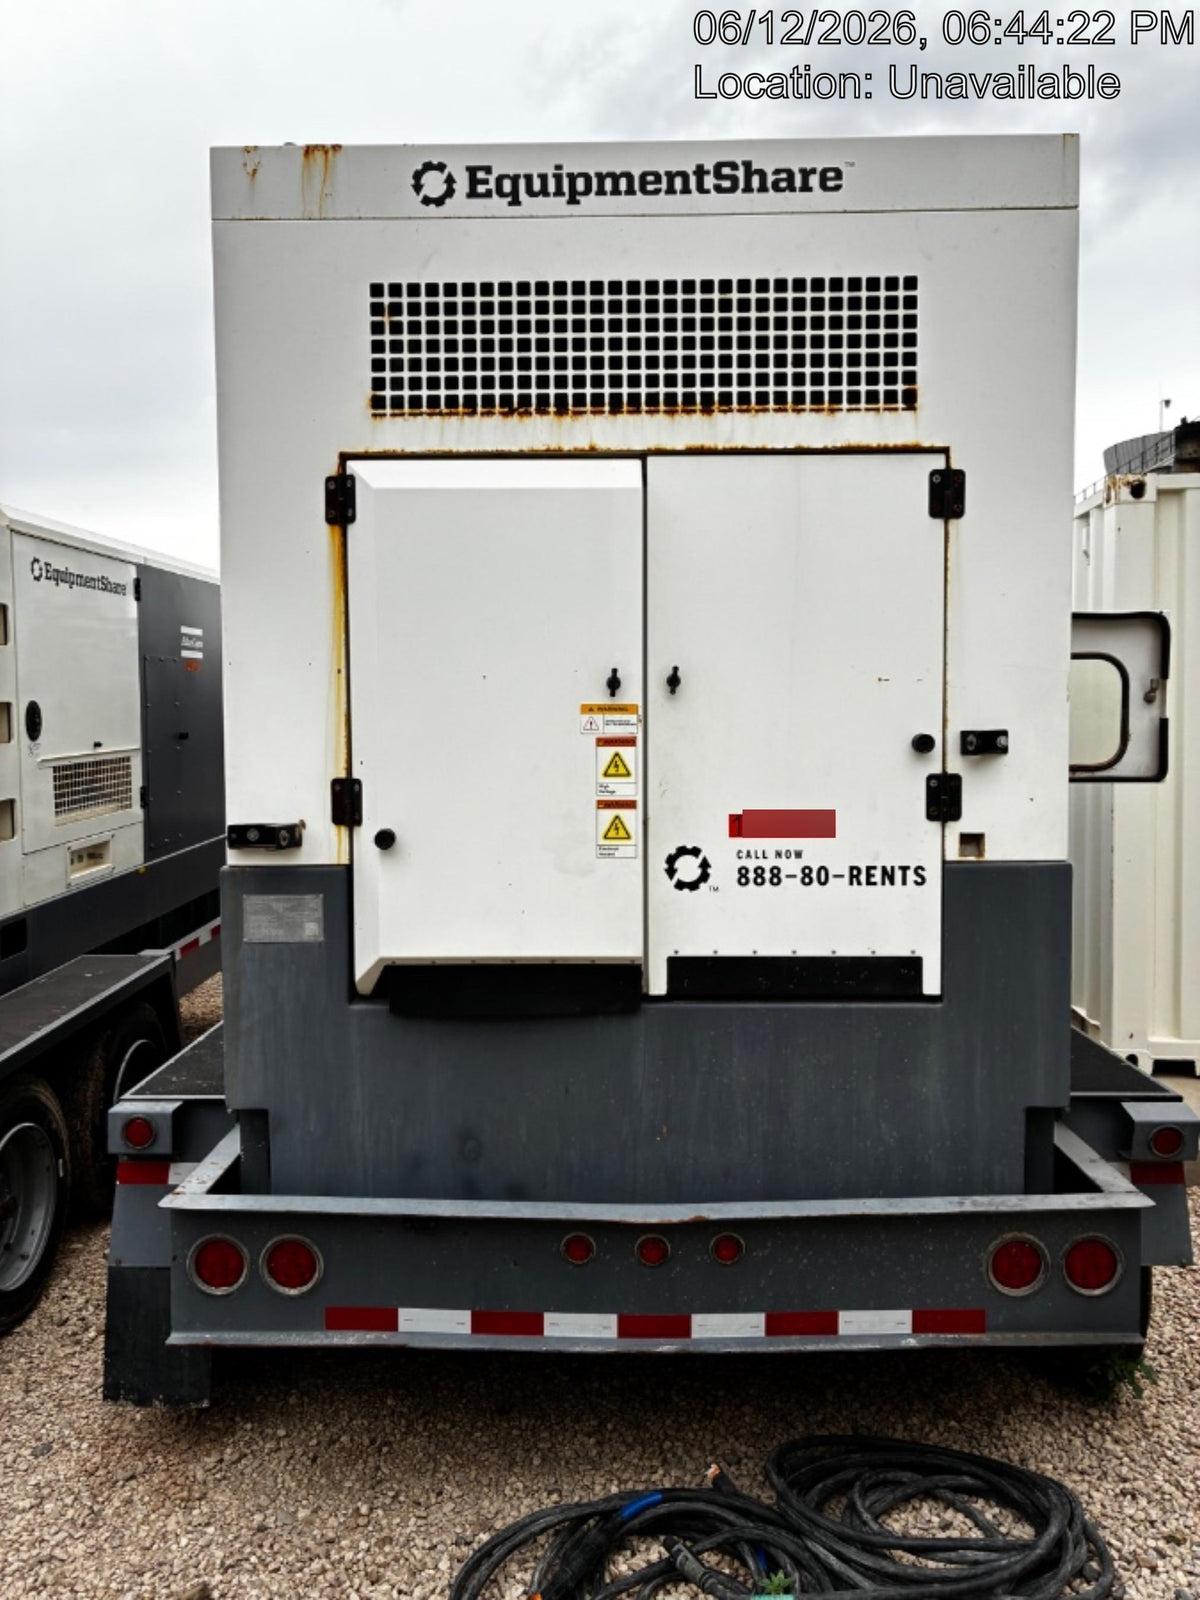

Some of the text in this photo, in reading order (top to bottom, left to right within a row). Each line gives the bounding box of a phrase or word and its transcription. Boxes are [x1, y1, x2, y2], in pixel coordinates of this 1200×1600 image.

[465, 160, 844, 206] EquipmentShare
[44, 561, 127, 596] EquipmentShare
[736, 849, 804, 860] CALL NOW
[736, 865, 928, 887] 888-80-RENTS
